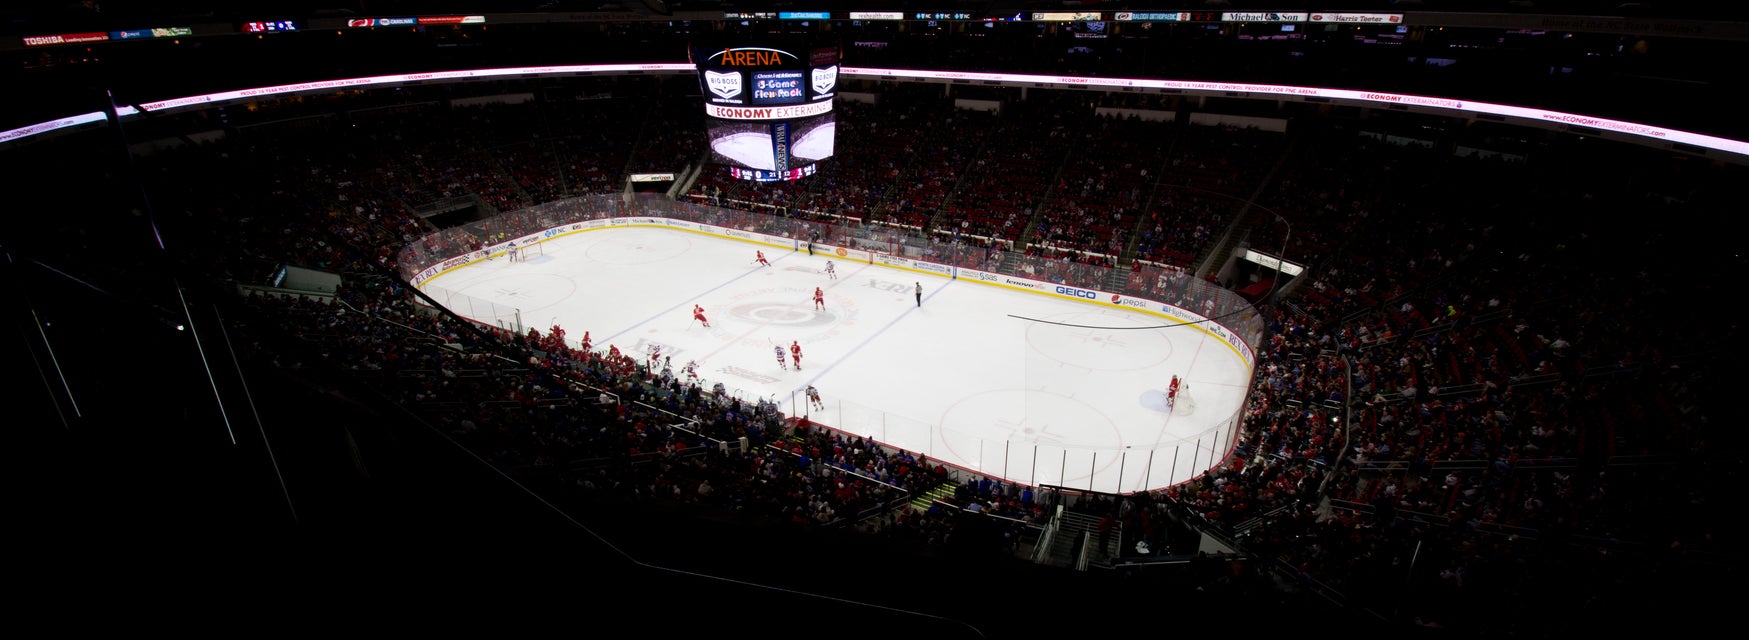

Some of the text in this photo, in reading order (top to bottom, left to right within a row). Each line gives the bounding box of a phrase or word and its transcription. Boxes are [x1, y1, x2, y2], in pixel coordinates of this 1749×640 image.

[1230, 13, 1264, 21] Michael
[1336, 14, 1358, 22] Harris
[24, 35, 65, 45] TOSHIBA
[721, 48, 782, 66] ARENA
[755, 90, 777, 98] Flex
[778, 89, 802, 98] Pack
[1366, 93, 1456, 108] ECONOMY EXTERMINATORS
[716, 107, 772, 118] ECONOMY
[778, 146, 786, 170] NEWS
[651, 175, 672, 183] verizon
[1006, 278, 1034, 288] lenovo
[1056, 286, 1096, 299] GEICO
[1122, 297, 1146, 308] pepsi
[1210, 326, 1226, 338] NHL.COM
[1229, 333, 1241, 352] REX
